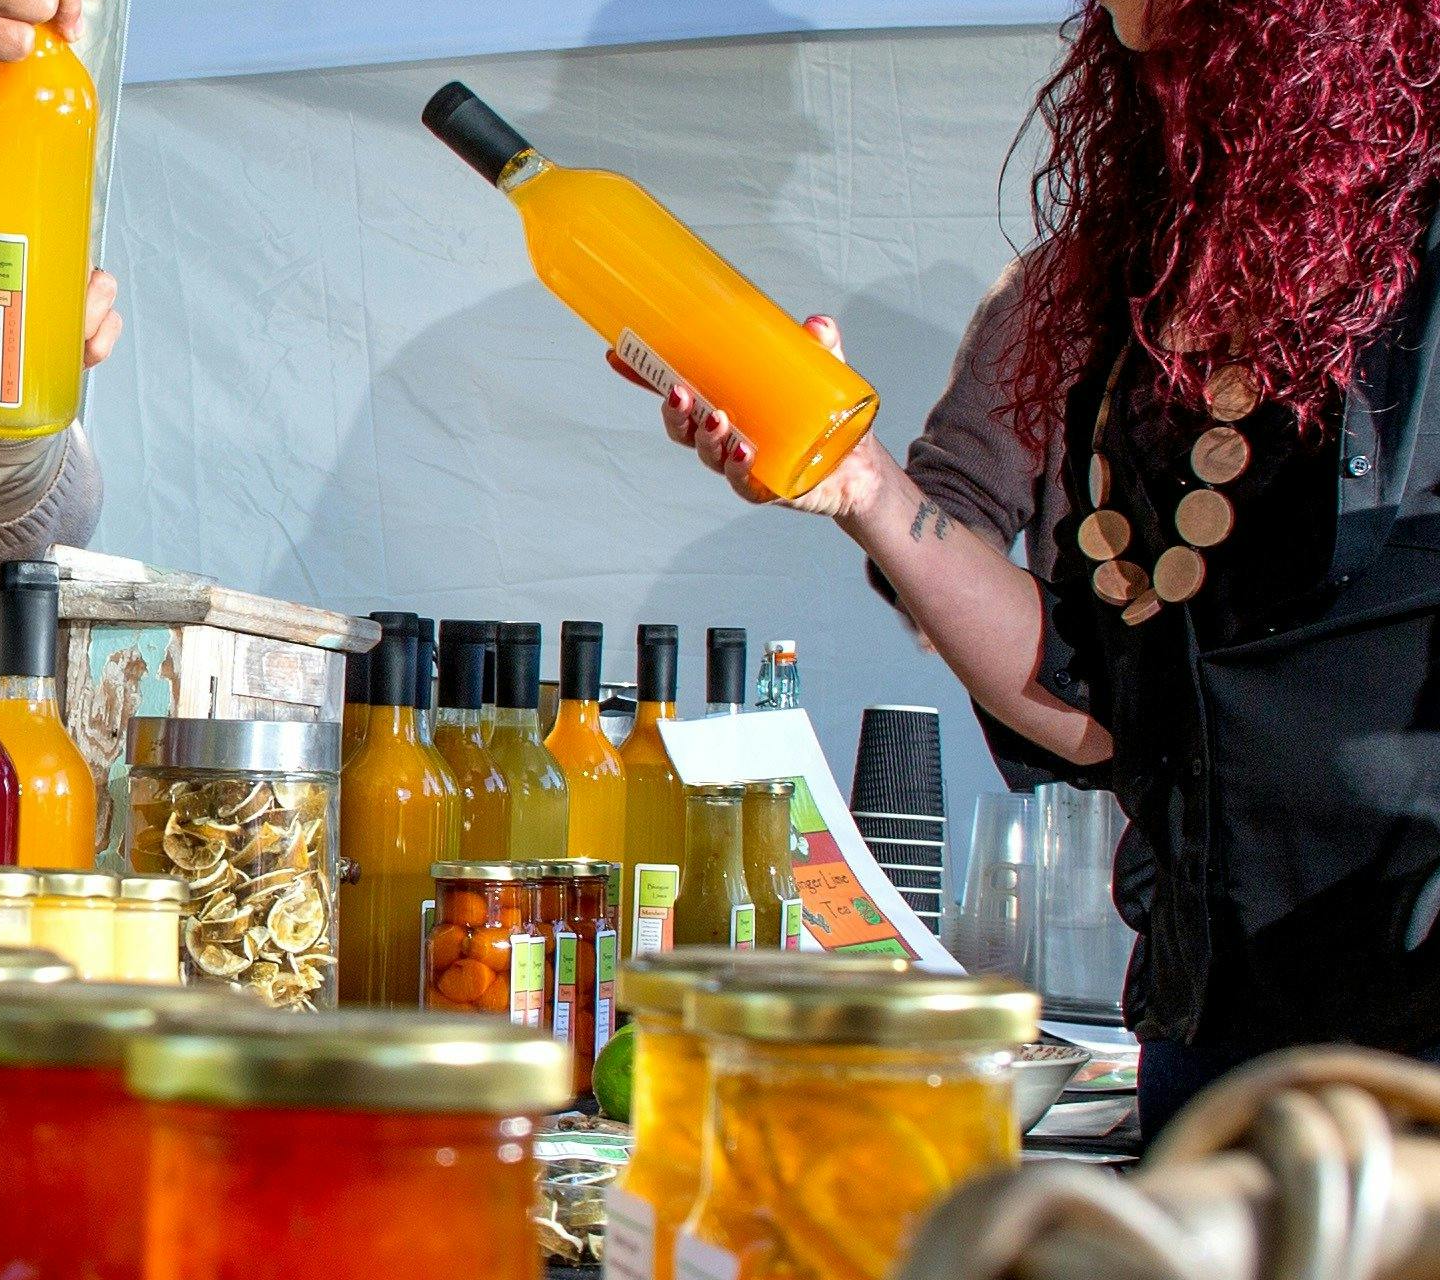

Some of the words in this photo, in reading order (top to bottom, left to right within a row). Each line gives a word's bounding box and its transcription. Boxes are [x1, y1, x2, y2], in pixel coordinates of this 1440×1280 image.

[794, 876, 823, 895] inger
[819, 870, 850, 890] Lime
[820, 900, 852, 919] Tea
